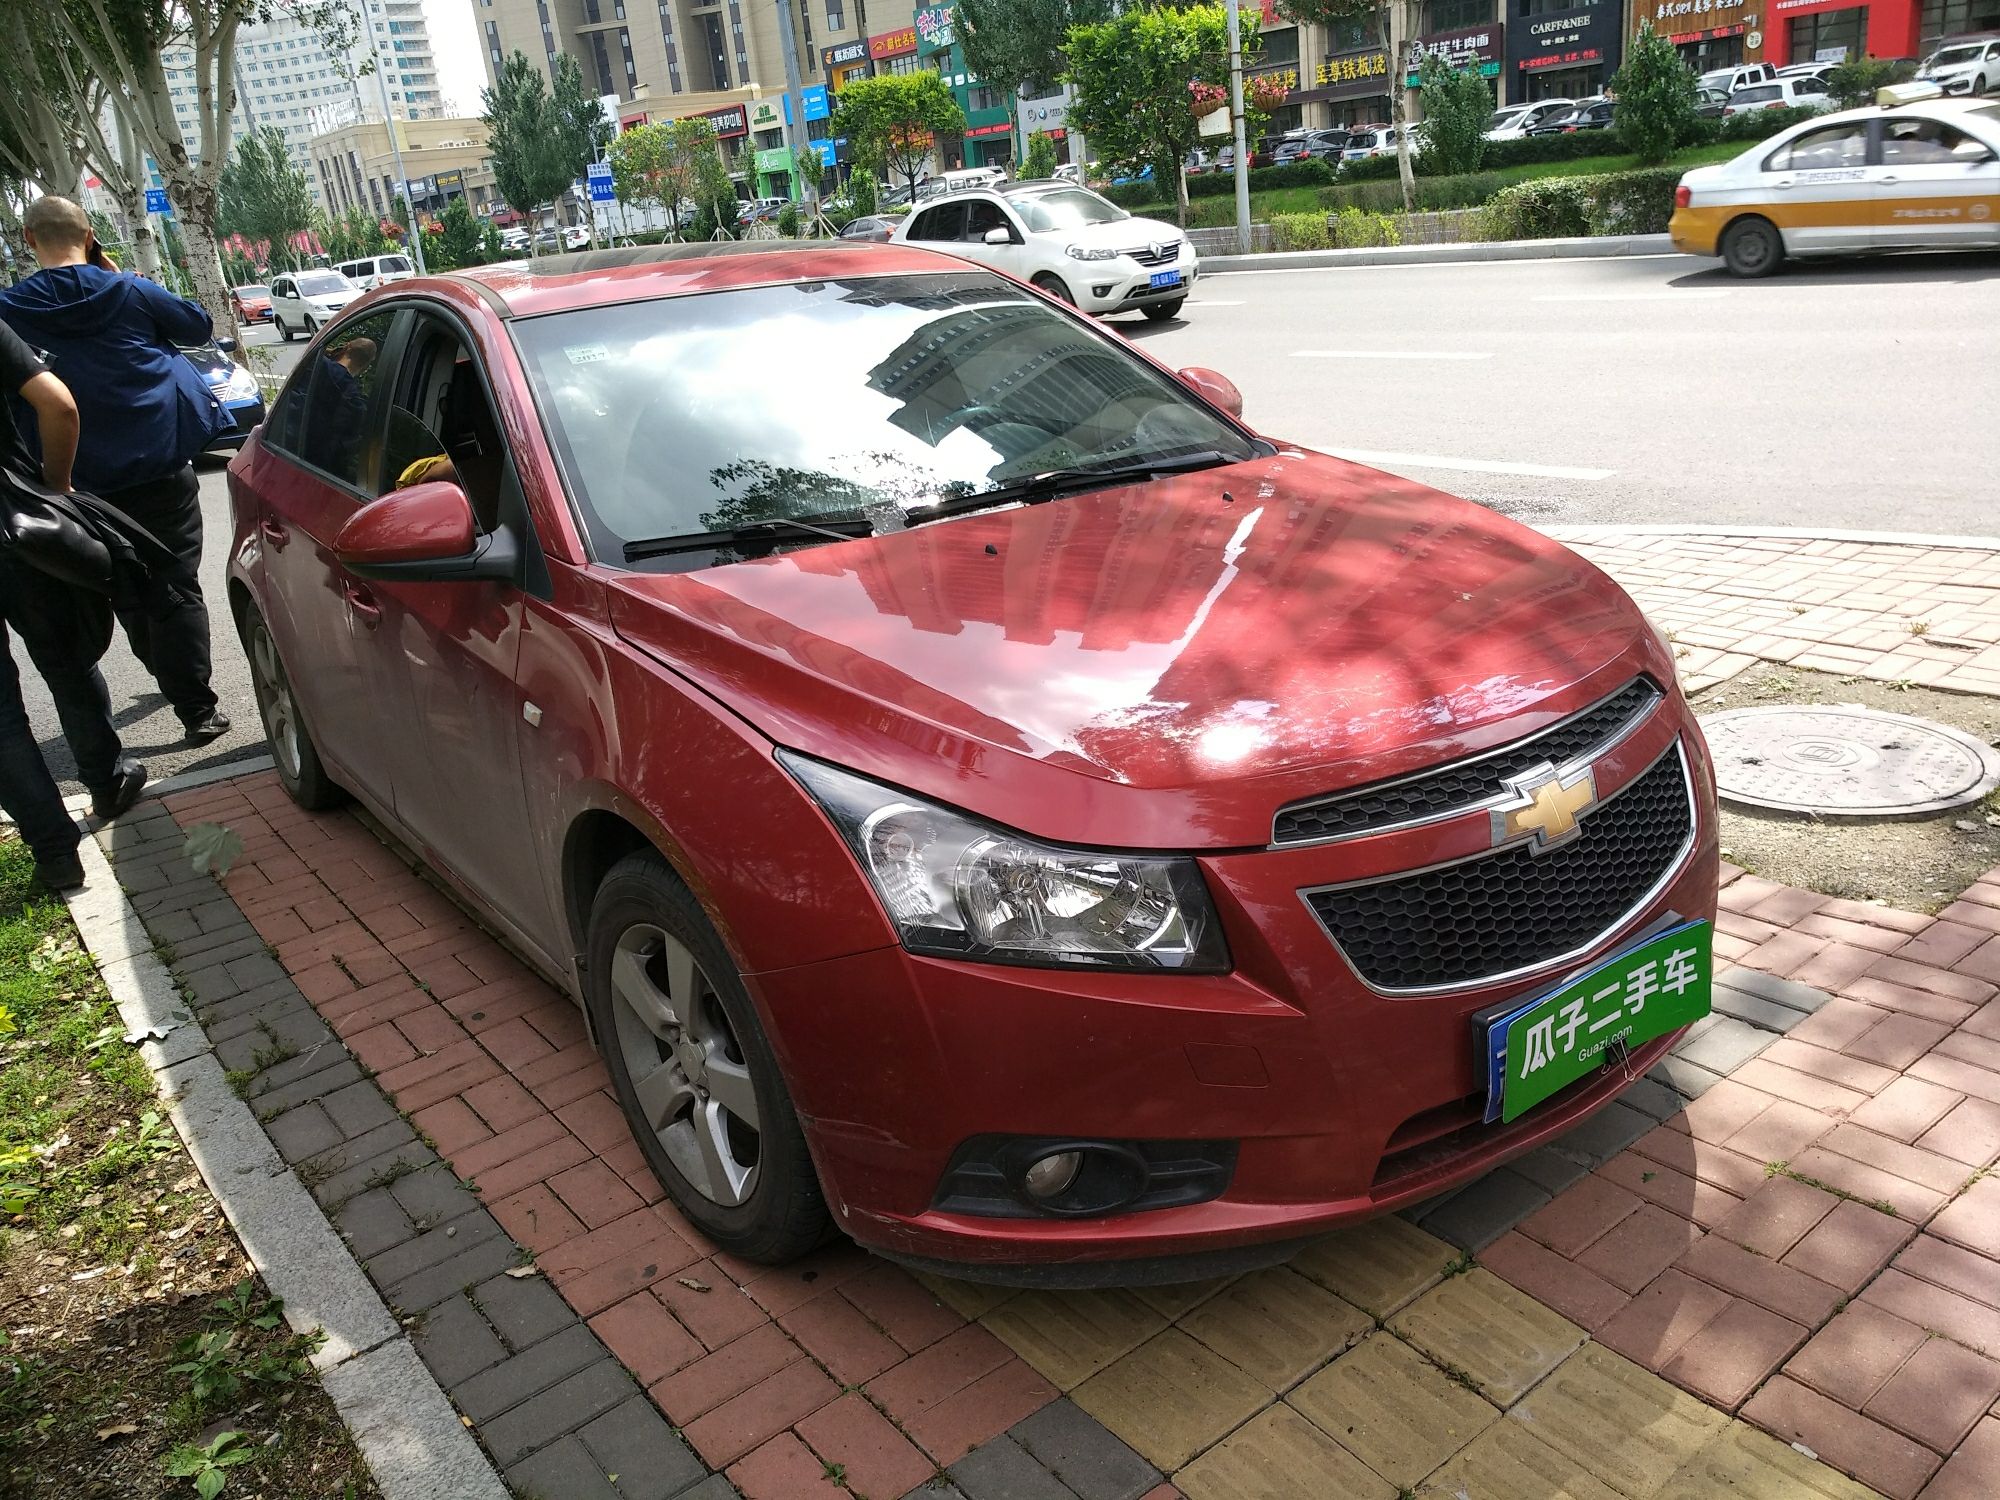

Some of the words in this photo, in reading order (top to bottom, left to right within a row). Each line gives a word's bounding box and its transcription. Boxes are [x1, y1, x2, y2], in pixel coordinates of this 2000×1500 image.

[1315, 53, 1386, 84] 至尊铁板烧
[1520, 947, 1698, 1080] 瓜子二手车
[1578, 1024, 1633, 1062] Guazi.com
